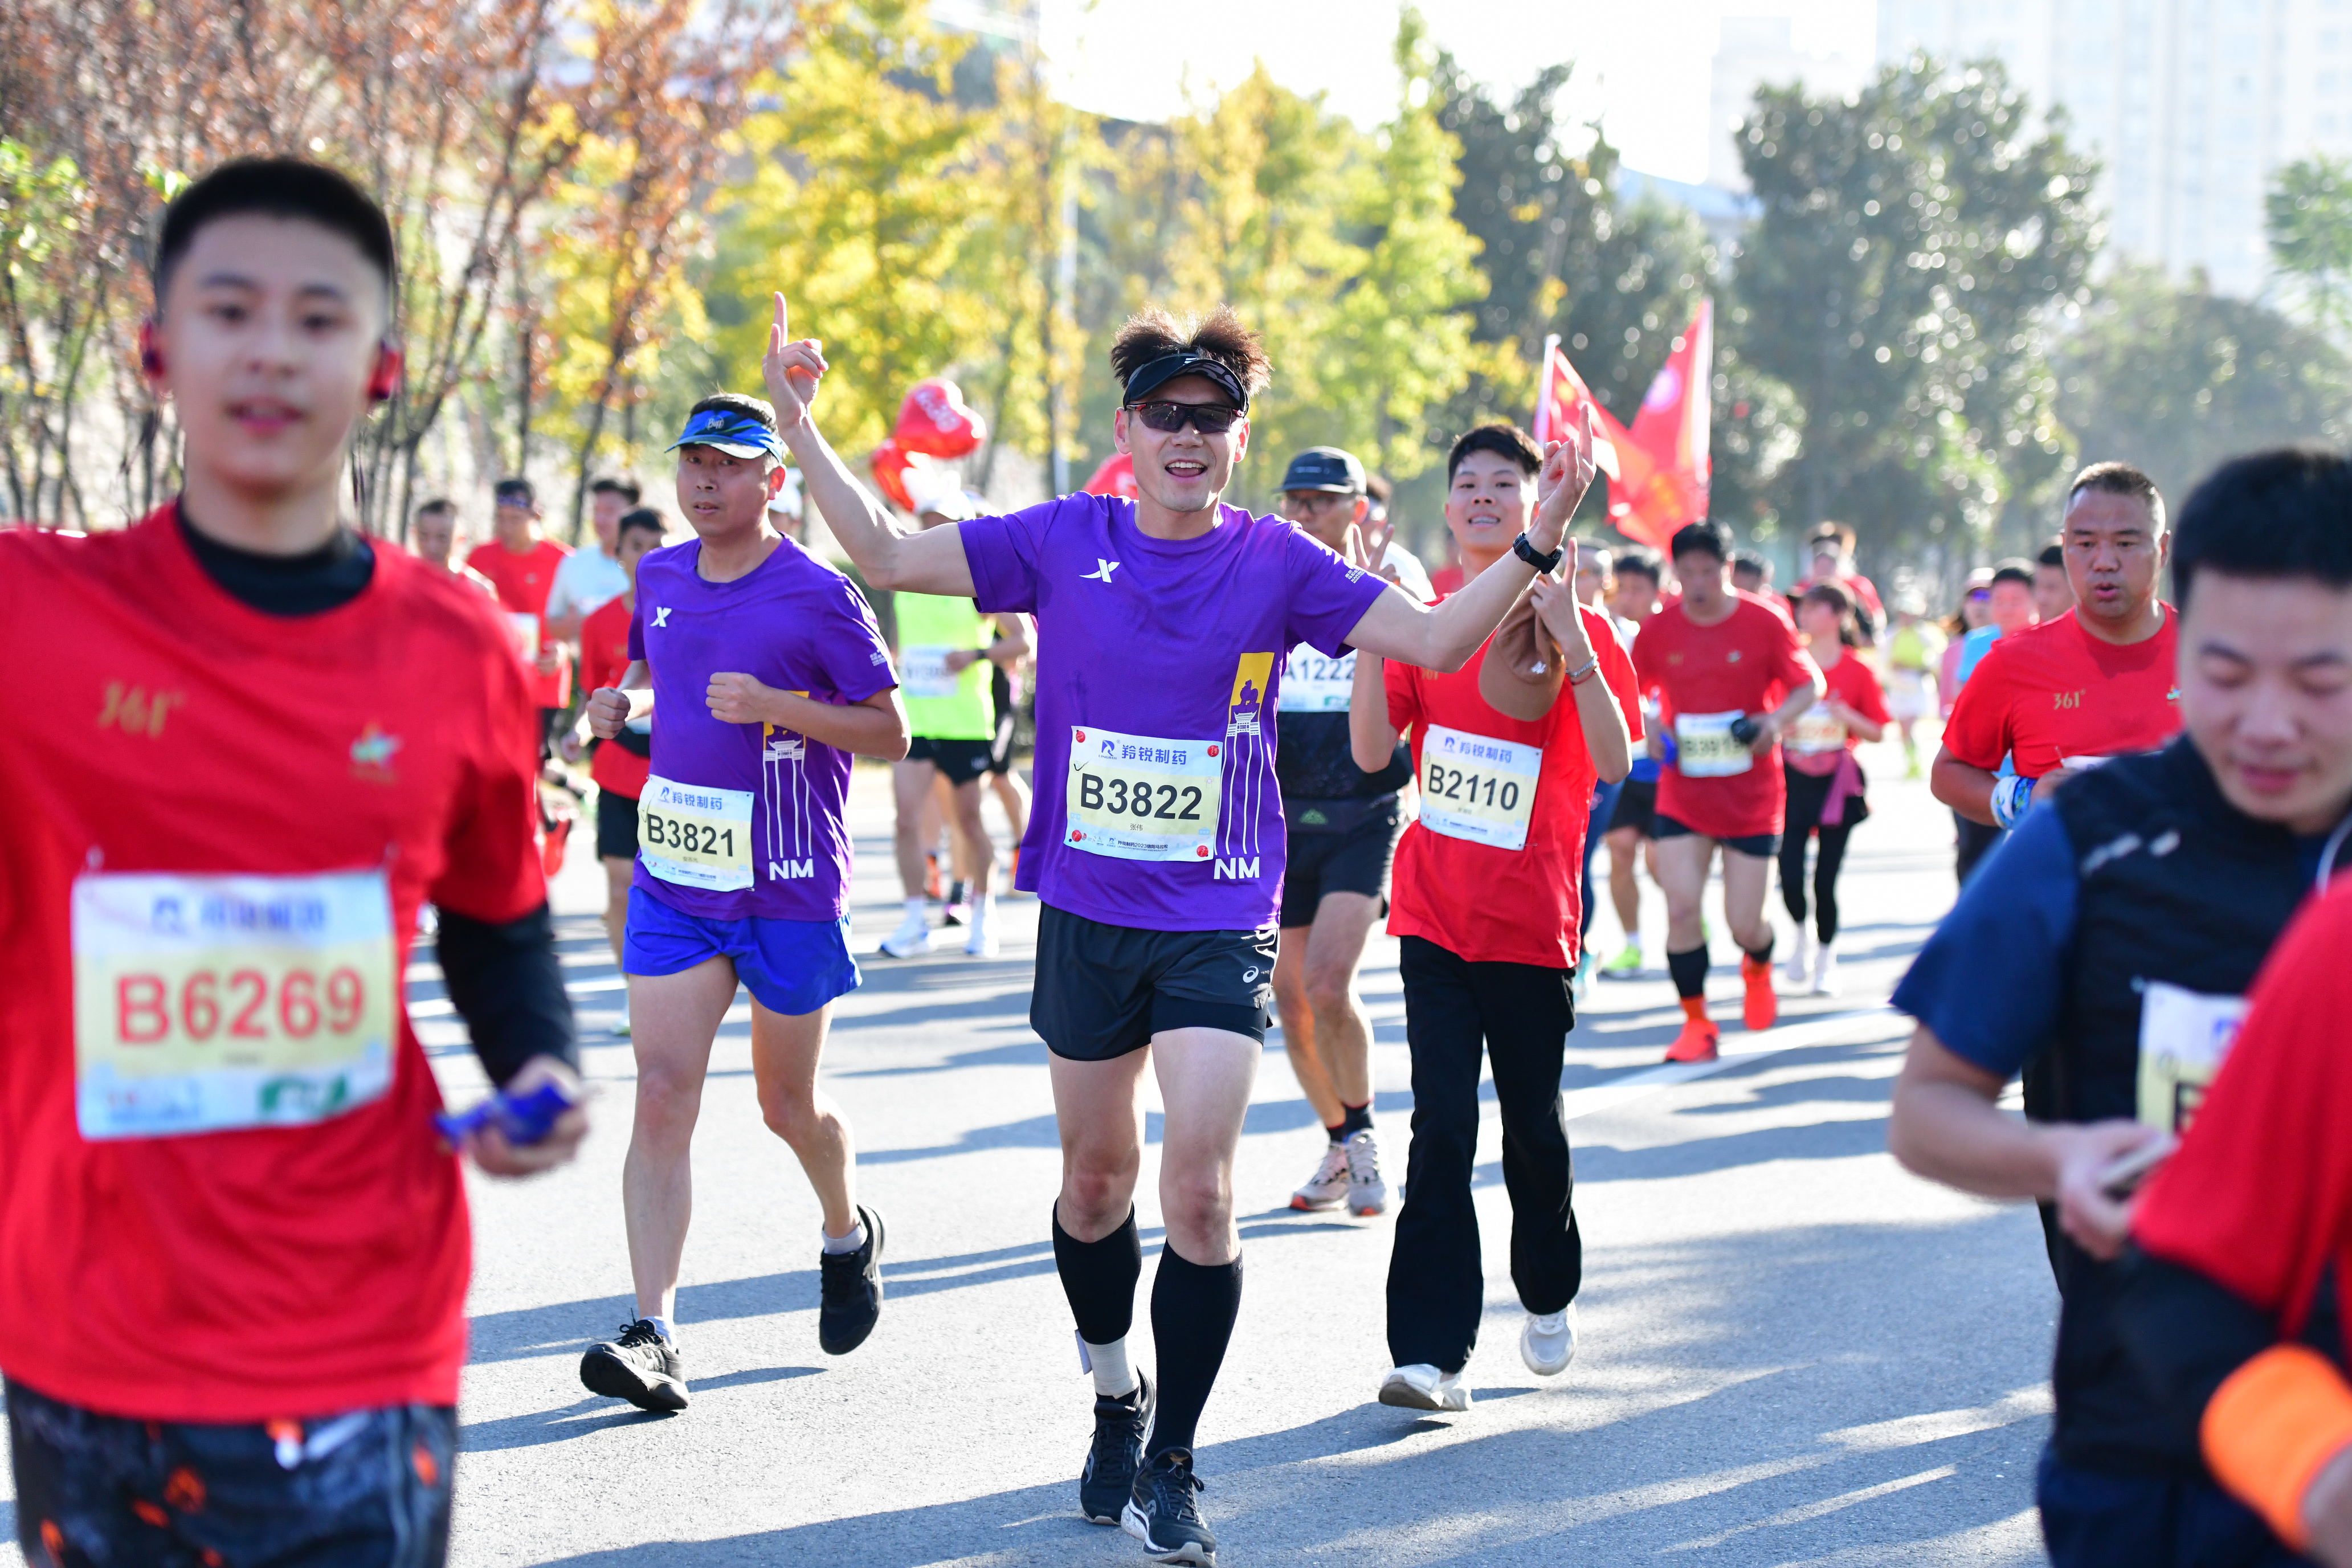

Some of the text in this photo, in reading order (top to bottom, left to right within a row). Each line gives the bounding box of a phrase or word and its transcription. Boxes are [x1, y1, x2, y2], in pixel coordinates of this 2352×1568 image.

[1121, 744, 1187, 765] 羚锐制药
[1459, 742, 1513, 763] 羚锐制药
[1080, 773, 1202, 820] B3822
[1428, 763, 1519, 811] B2110
[672, 791, 722, 810] 羚锐制药
[647, 813, 733, 857] B3821
[769, 858, 814, 881] NM
[1214, 856, 1260, 880] NM
[119, 967, 364, 1044] B6269
